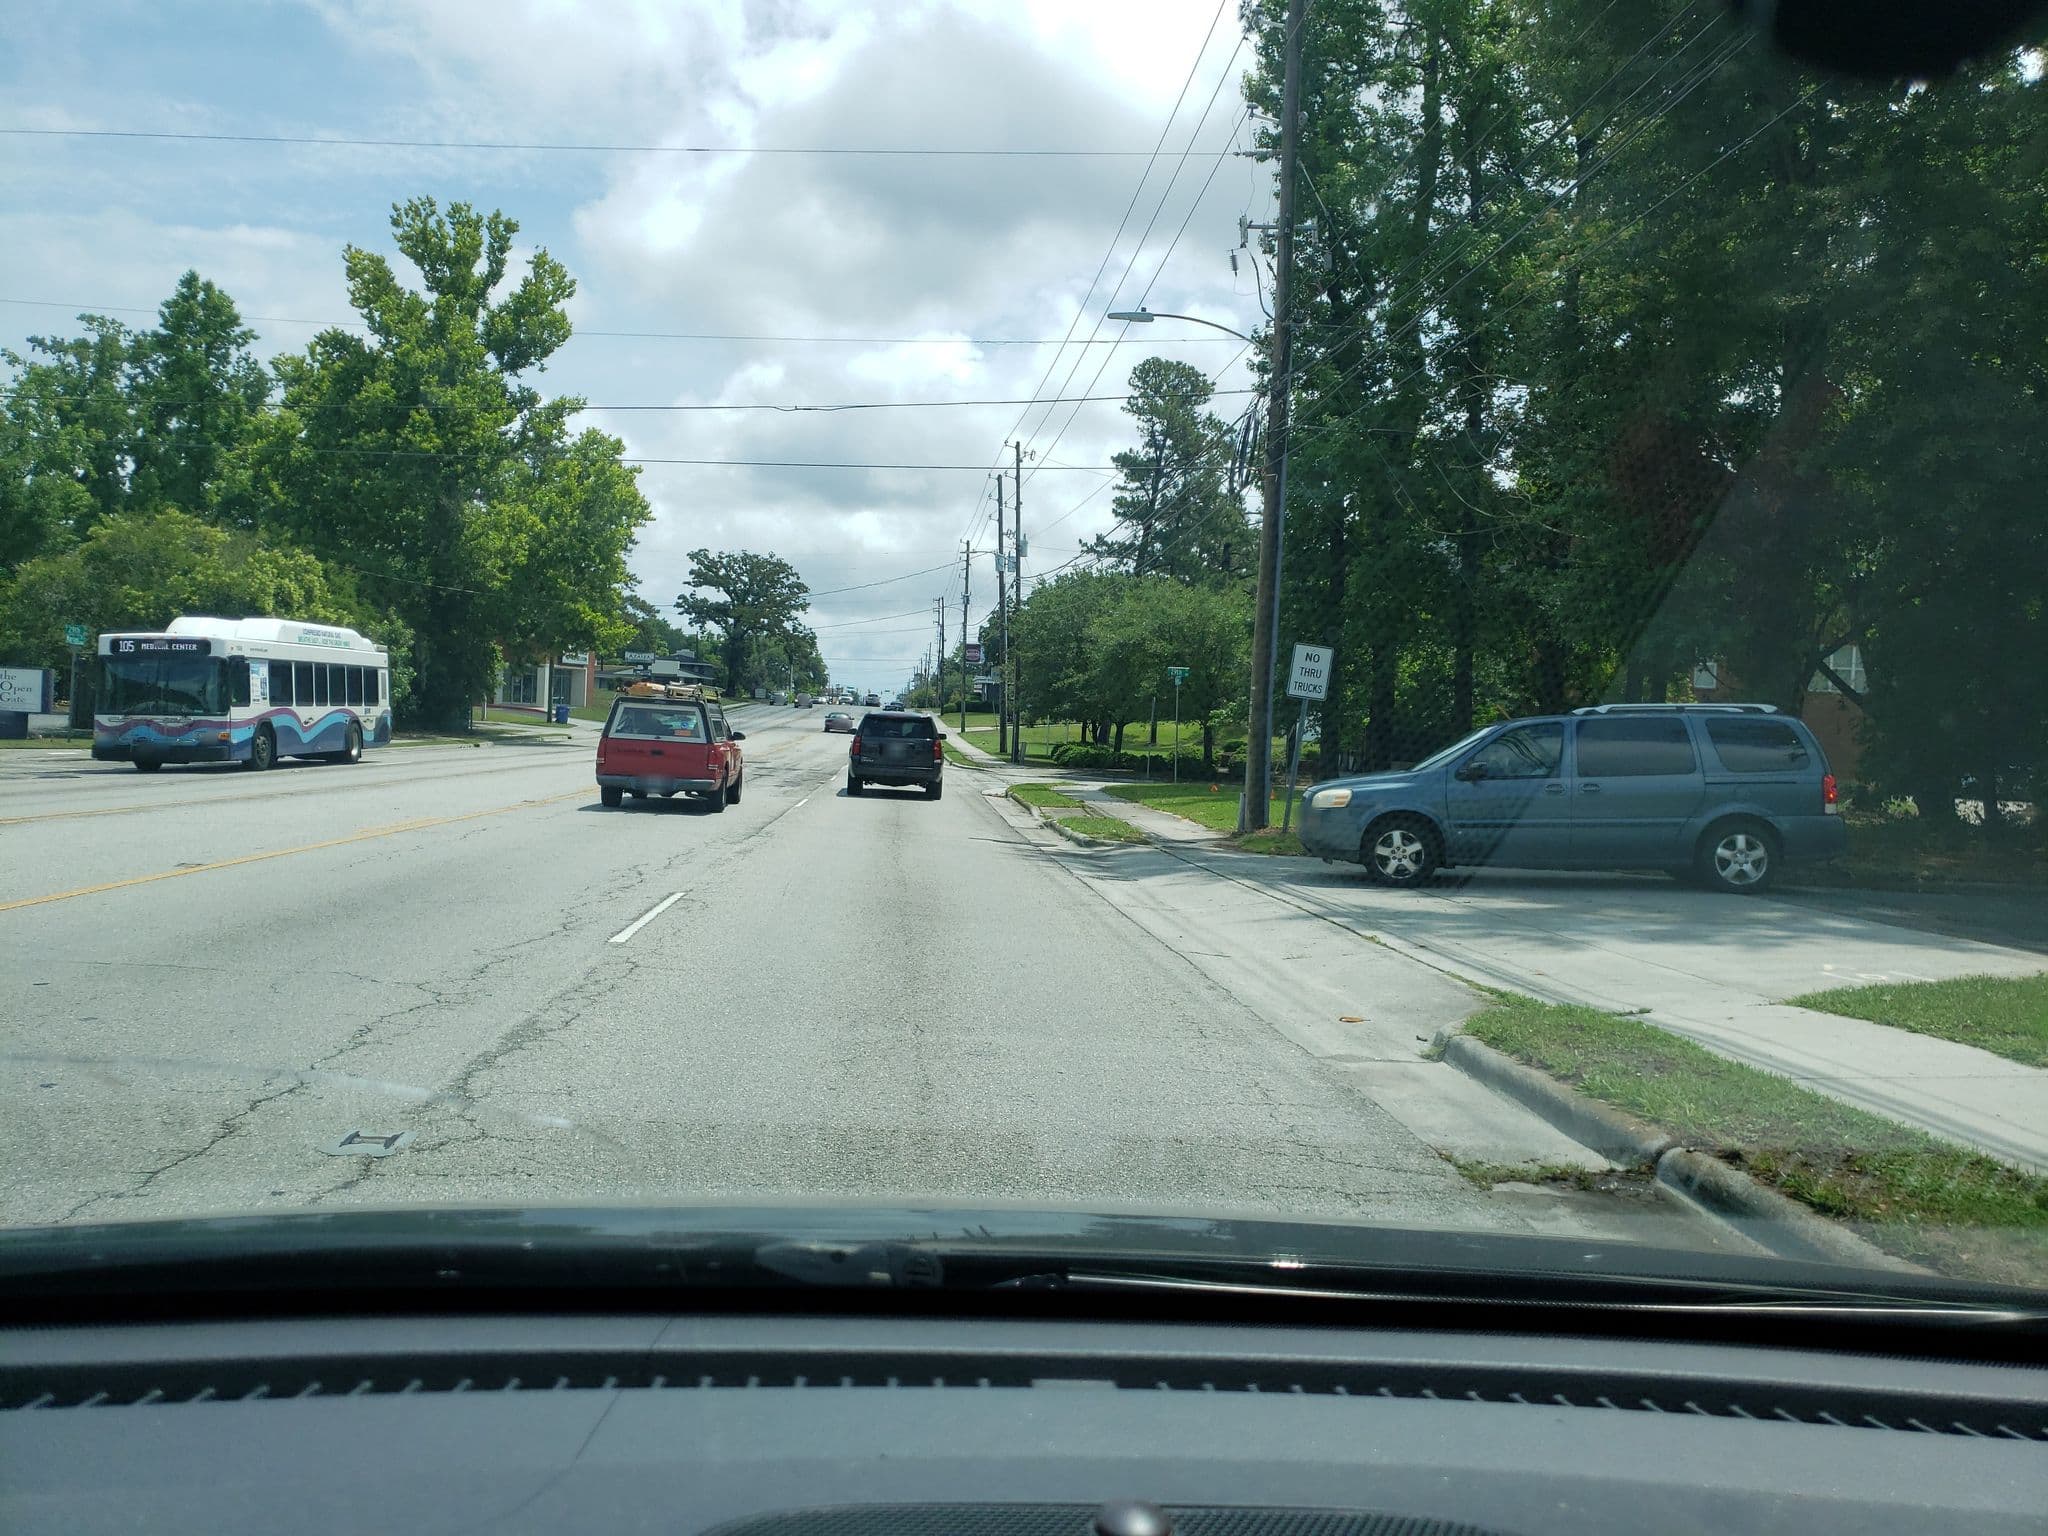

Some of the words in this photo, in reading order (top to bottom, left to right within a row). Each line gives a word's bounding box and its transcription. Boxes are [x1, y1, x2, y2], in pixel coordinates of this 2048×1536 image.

[119, 640, 135, 652] 105
[171, 643, 197, 651] CENTER
[1304, 652, 1320, 663] NO
[0, 669, 17, 680] the
[1299, 666, 1322, 679] THRU
[0, 681, 32, 695] Open
[1293, 681, 1323, 694] TRUCKS
